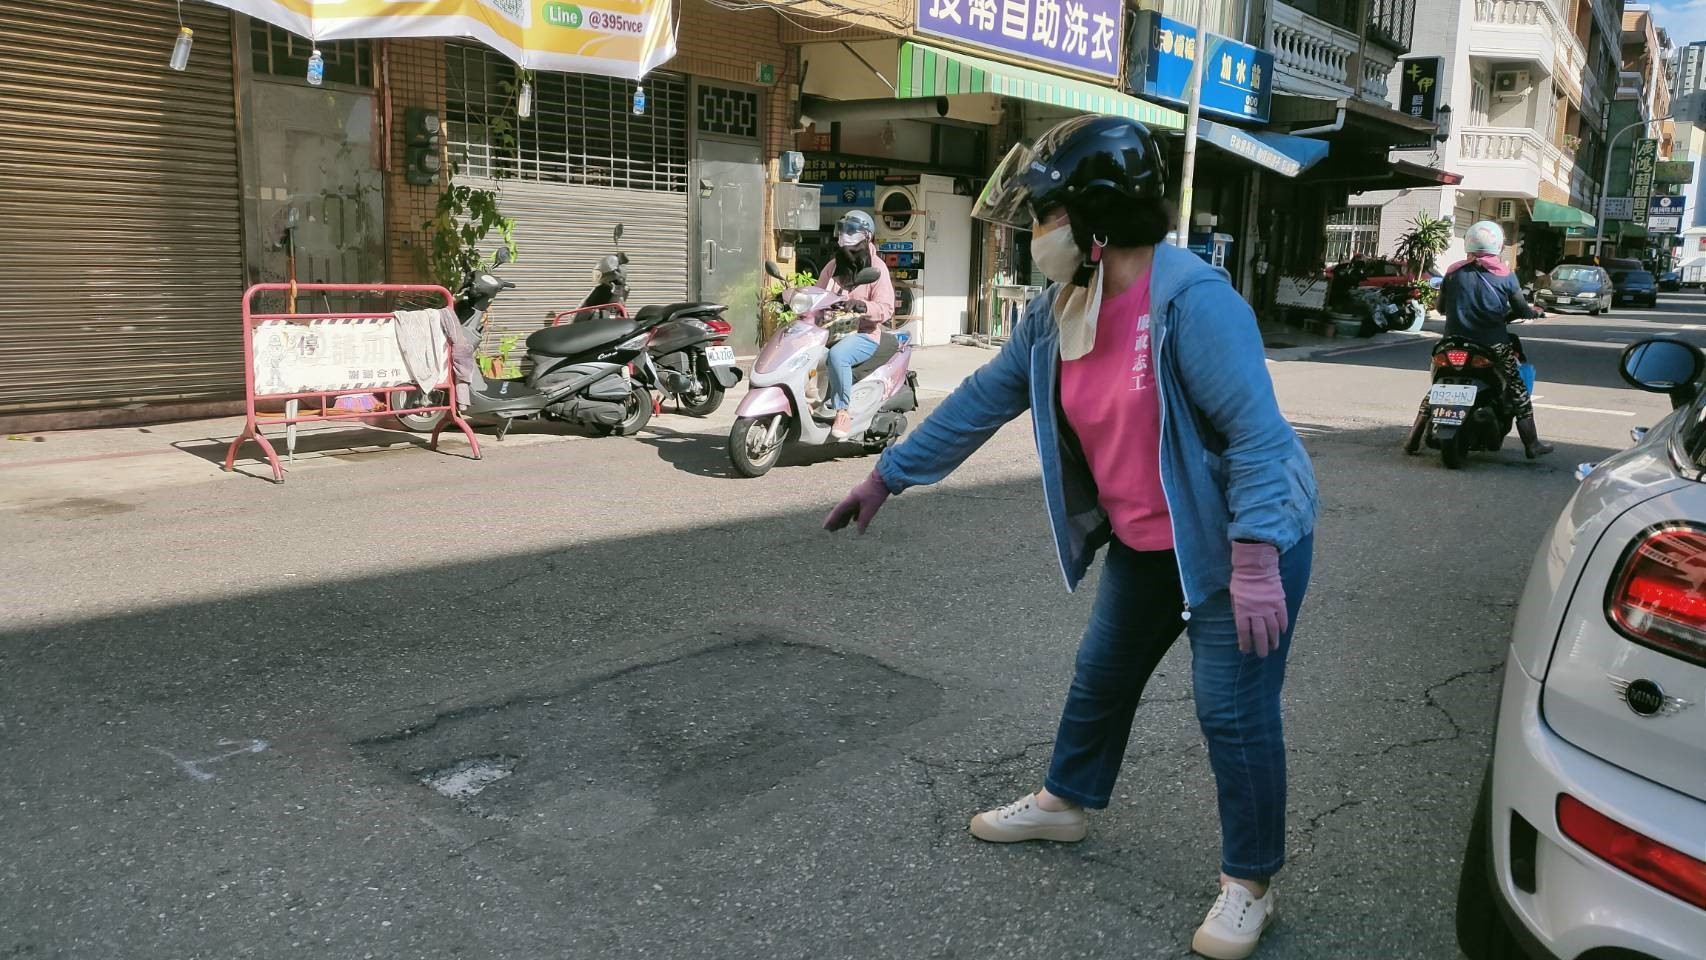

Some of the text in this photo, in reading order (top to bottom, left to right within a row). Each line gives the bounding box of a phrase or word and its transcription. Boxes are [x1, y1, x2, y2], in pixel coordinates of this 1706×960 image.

[549, 5, 644, 33] Line @395rvce
[1220, 51, 1262, 90] 加水站
[1631, 688, 1660, 707] MINI
